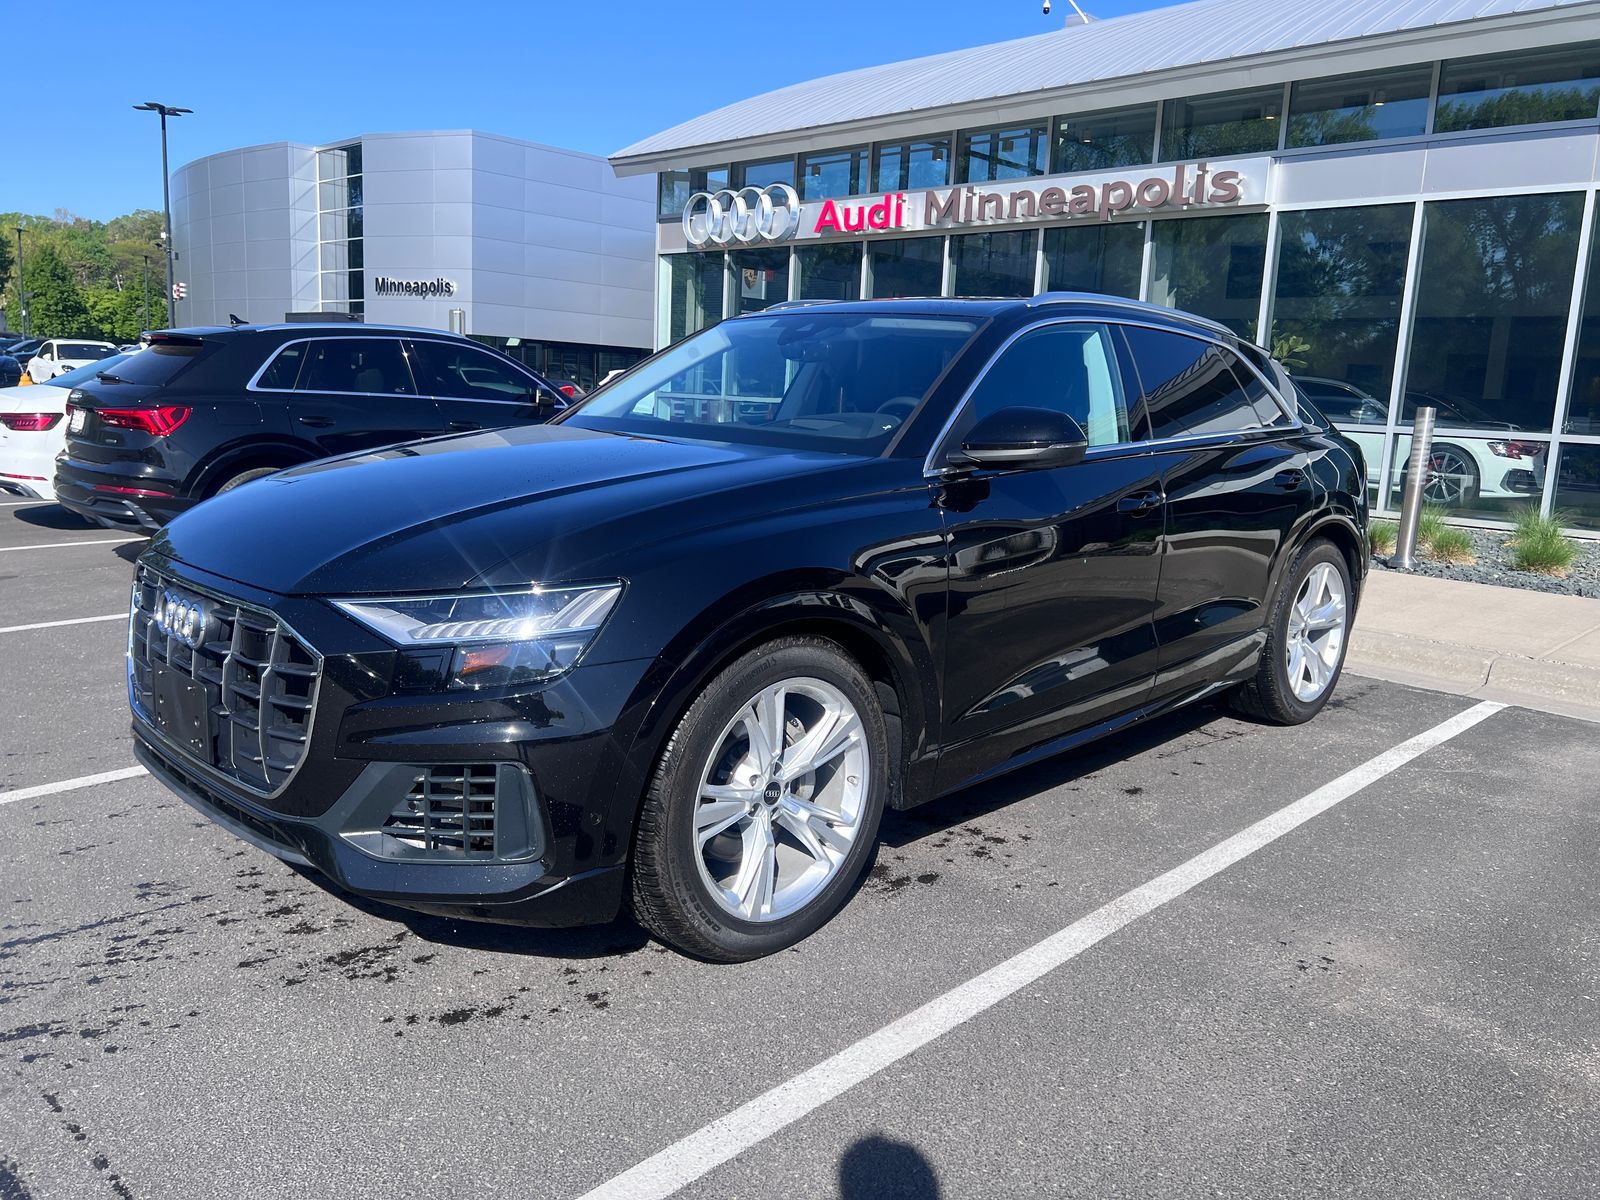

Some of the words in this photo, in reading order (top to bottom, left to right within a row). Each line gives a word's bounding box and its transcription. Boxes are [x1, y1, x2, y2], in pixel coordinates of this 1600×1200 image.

[814, 192, 904, 233] Audi
[924, 162, 1240, 224] Minneapolis
[375, 277, 453, 299] Minneapolis
